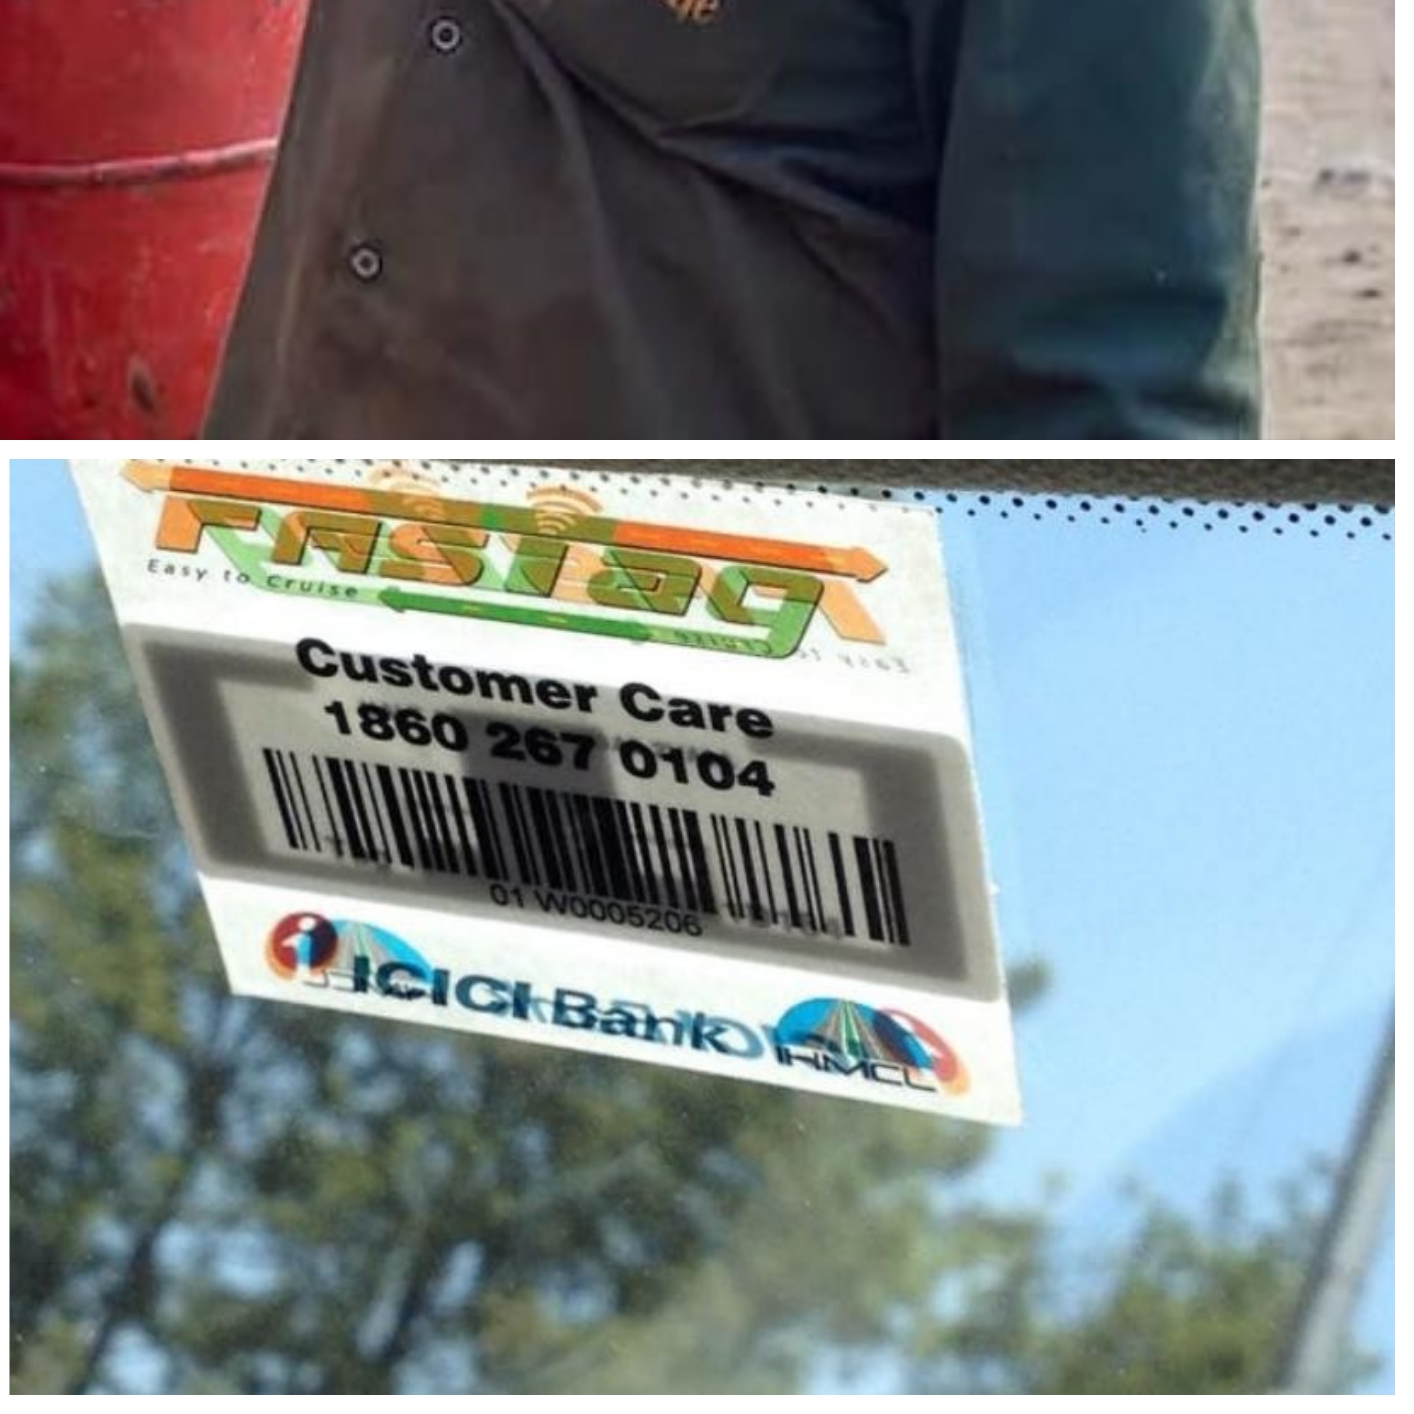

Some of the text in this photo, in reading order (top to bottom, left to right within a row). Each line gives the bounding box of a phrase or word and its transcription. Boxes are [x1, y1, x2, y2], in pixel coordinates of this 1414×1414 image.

[146, 559, 208, 582] Easy
[223, 569, 251, 586] to
[295, 636, 775, 741] Customer Care
[323, 699, 776, 798] 1860 267 0104
[490, 884, 525, 909] 01
[535, 889, 704, 939] W0005206
[353, 953, 532, 1021] ICICI
[554, 987, 730, 1058] Bank
